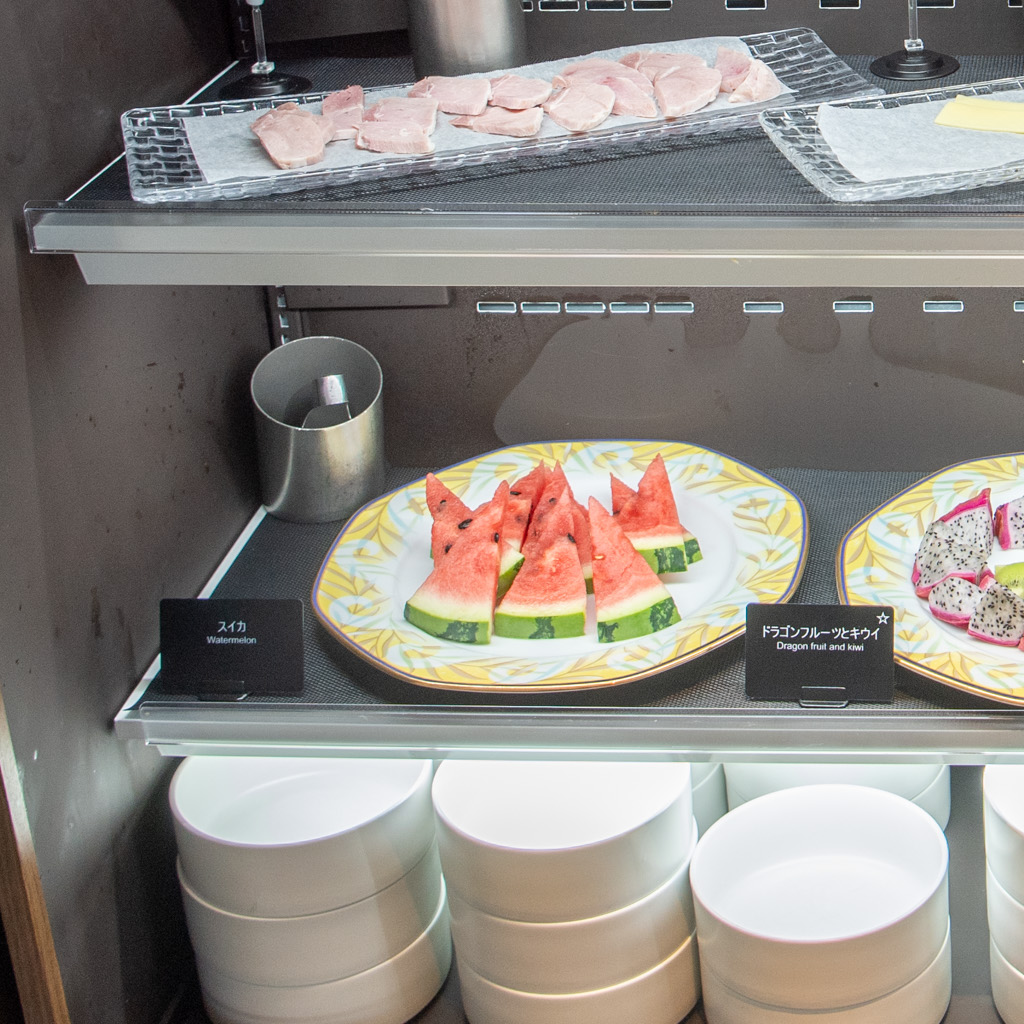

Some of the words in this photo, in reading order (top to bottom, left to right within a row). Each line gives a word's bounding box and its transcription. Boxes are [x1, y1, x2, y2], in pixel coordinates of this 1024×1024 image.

[217, 620, 246, 633] スイカ
[762, 625, 880, 640] ドラゴンフルーツとキウイ
[206, 636, 257, 644] Watermelon
[776, 642, 808, 652] Dragon
[810, 642, 827, 651] fruit
[829, 642, 845, 651] and
[847, 642, 864, 651] kiwi
